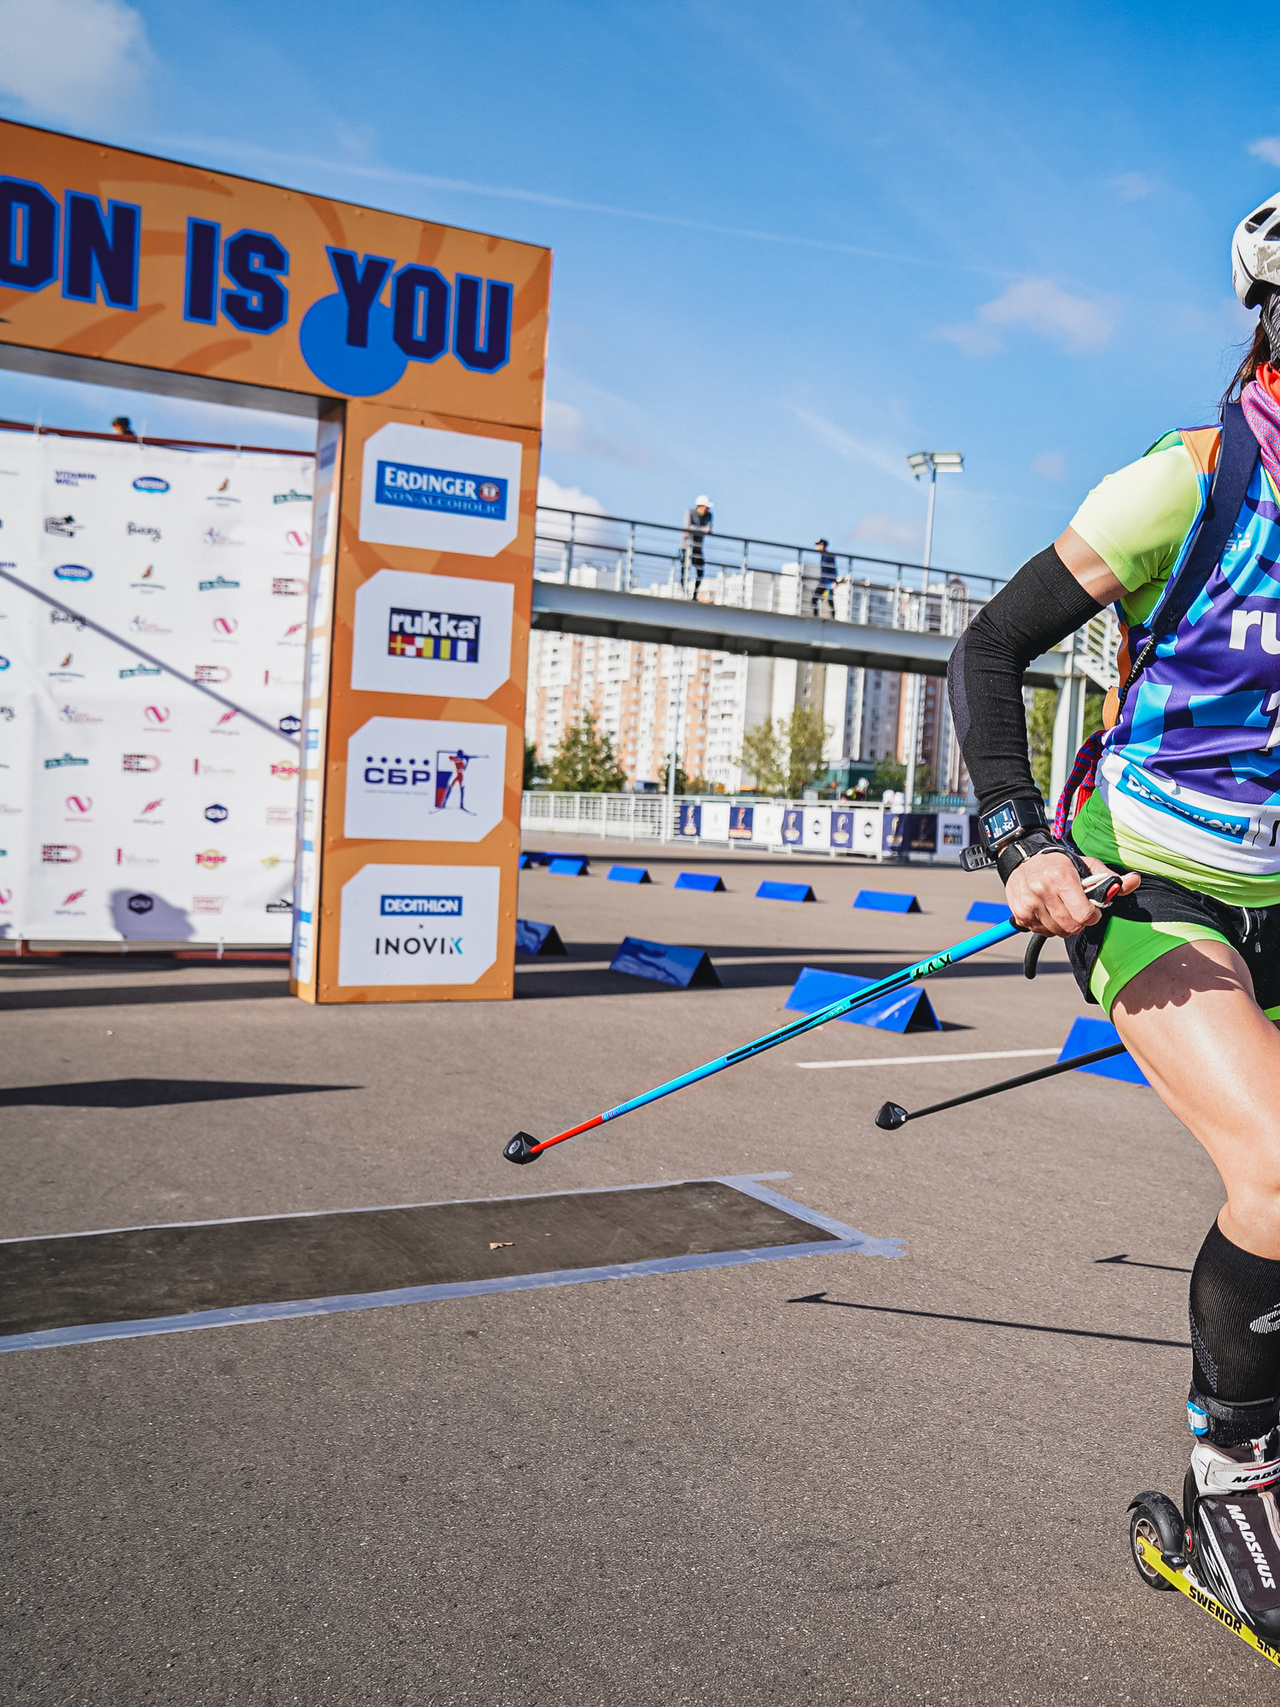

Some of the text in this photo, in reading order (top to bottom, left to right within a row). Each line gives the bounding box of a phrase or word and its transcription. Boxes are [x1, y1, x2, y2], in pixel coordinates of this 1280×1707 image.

[184, 216, 290, 335] IS
[325, 245, 514, 375] YOU
[384, 465, 478, 501] ERDINGER
[384, 488, 500, 515] NON-ALCOHOLIC
[390, 610, 477, 640] rukka
[364, 767, 431, 786] СБР
[384, 898, 460, 914] DECATHLON
[374, 937, 464, 955] INOVIK
[1225, 1503, 1277, 1590] MADSHUS
[1188, 1585, 1243, 1635] SWENOR
